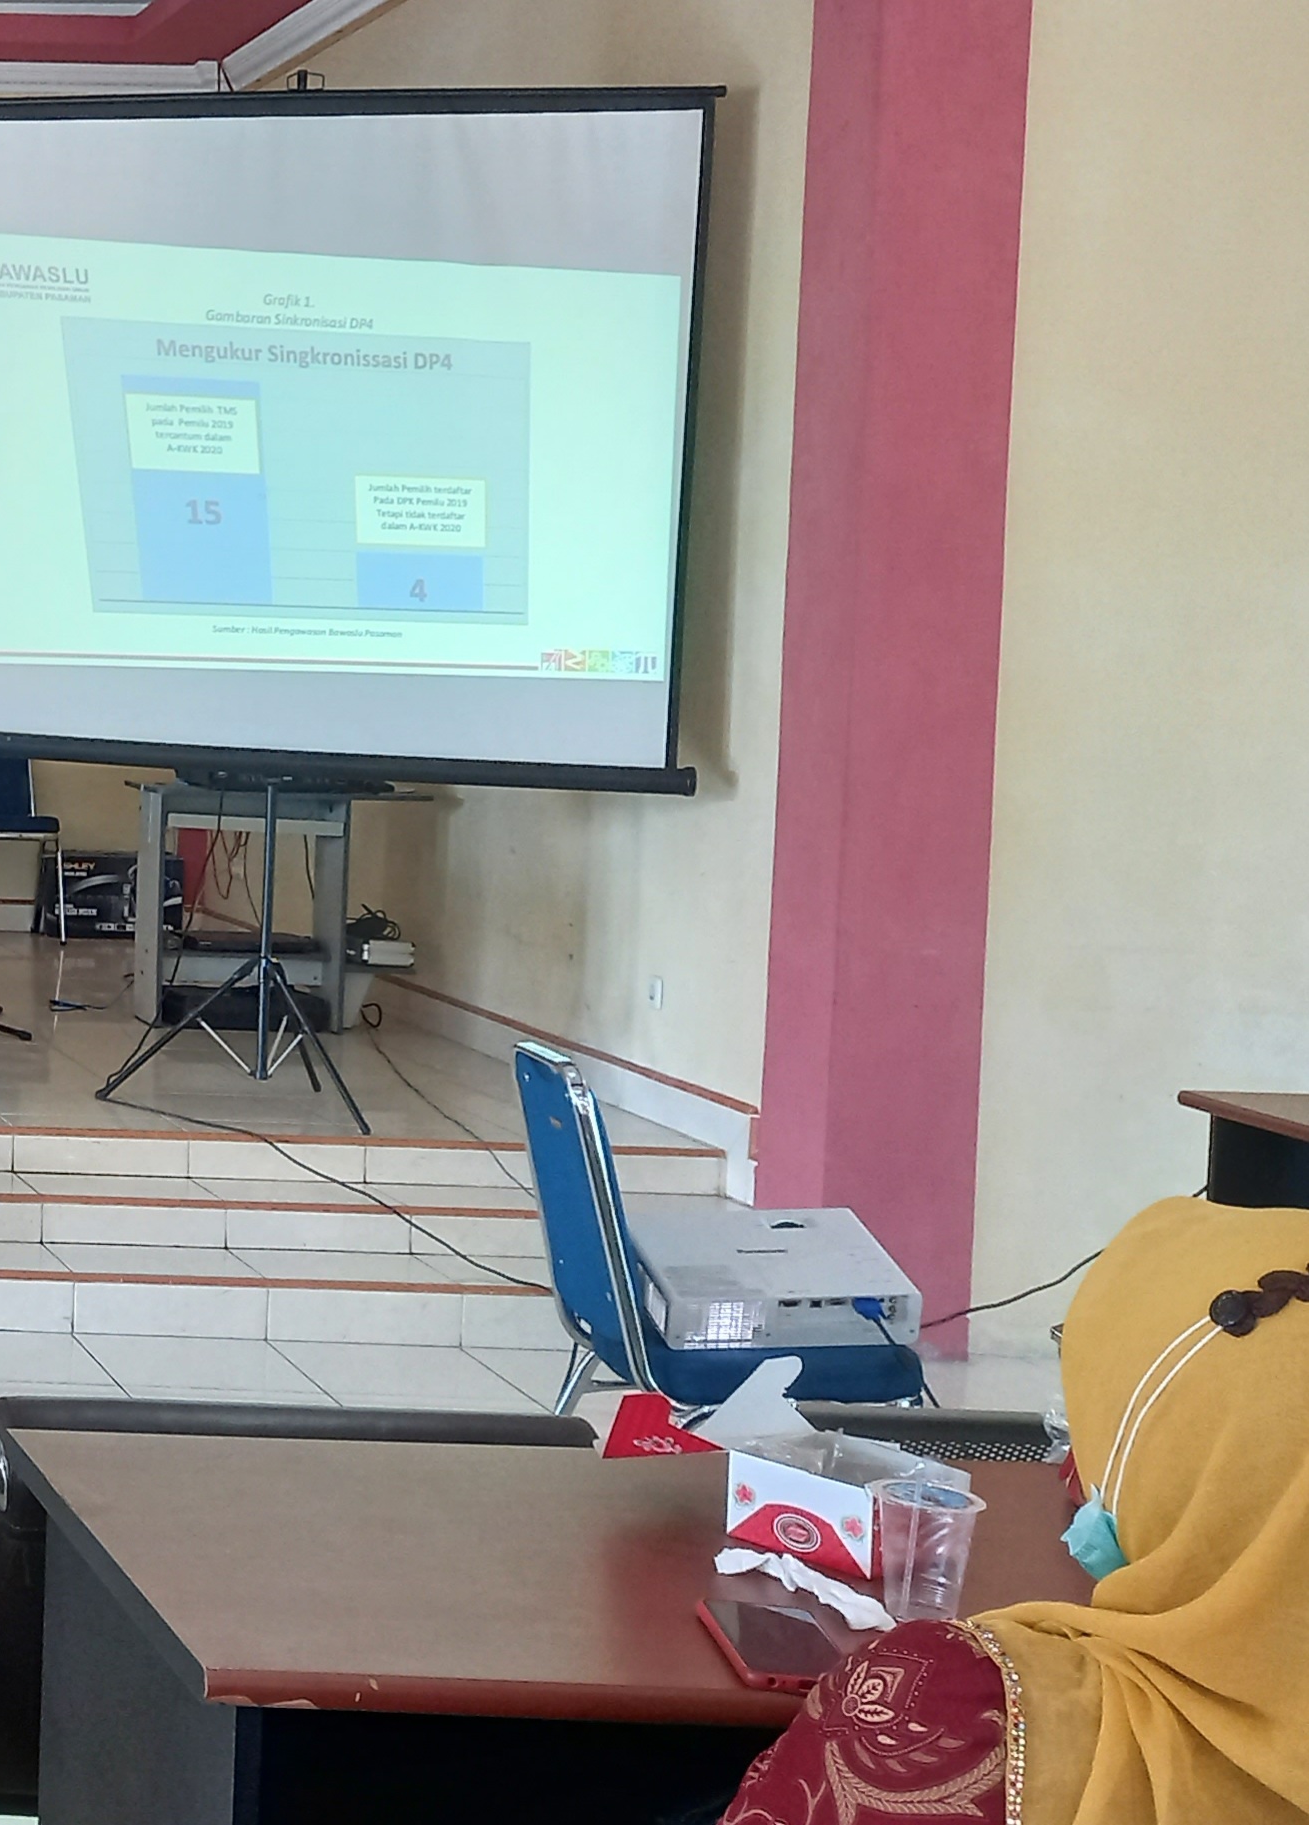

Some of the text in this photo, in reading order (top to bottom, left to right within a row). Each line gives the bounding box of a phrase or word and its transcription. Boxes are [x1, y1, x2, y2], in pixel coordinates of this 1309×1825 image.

[263, 293, 300, 308] Grafik
[205, 309, 374, 330] Gambaran Sinkronisasi DP4
[156, 338, 453, 371] Mengukur Singkronissasi DP4
[155, 431, 232, 441] tercantum dalam
[200, 445, 223, 454] 2020
[368, 484, 472, 496] Jumlah Pemilih terdaftar
[185, 499, 222, 525] 15
[377, 509, 466, 520] Tetapi tidak terdaftar
[381, 522, 407, 530] dalam
[441, 523, 461, 532] 2020
[409, 578, 428, 602] 4
[212, 625, 245, 634] Sumber
[273, 626, 327, 637] Pengawasan
[328, 628, 364, 638] Bawaslu
[364, 629, 403, 638] Pasaman
